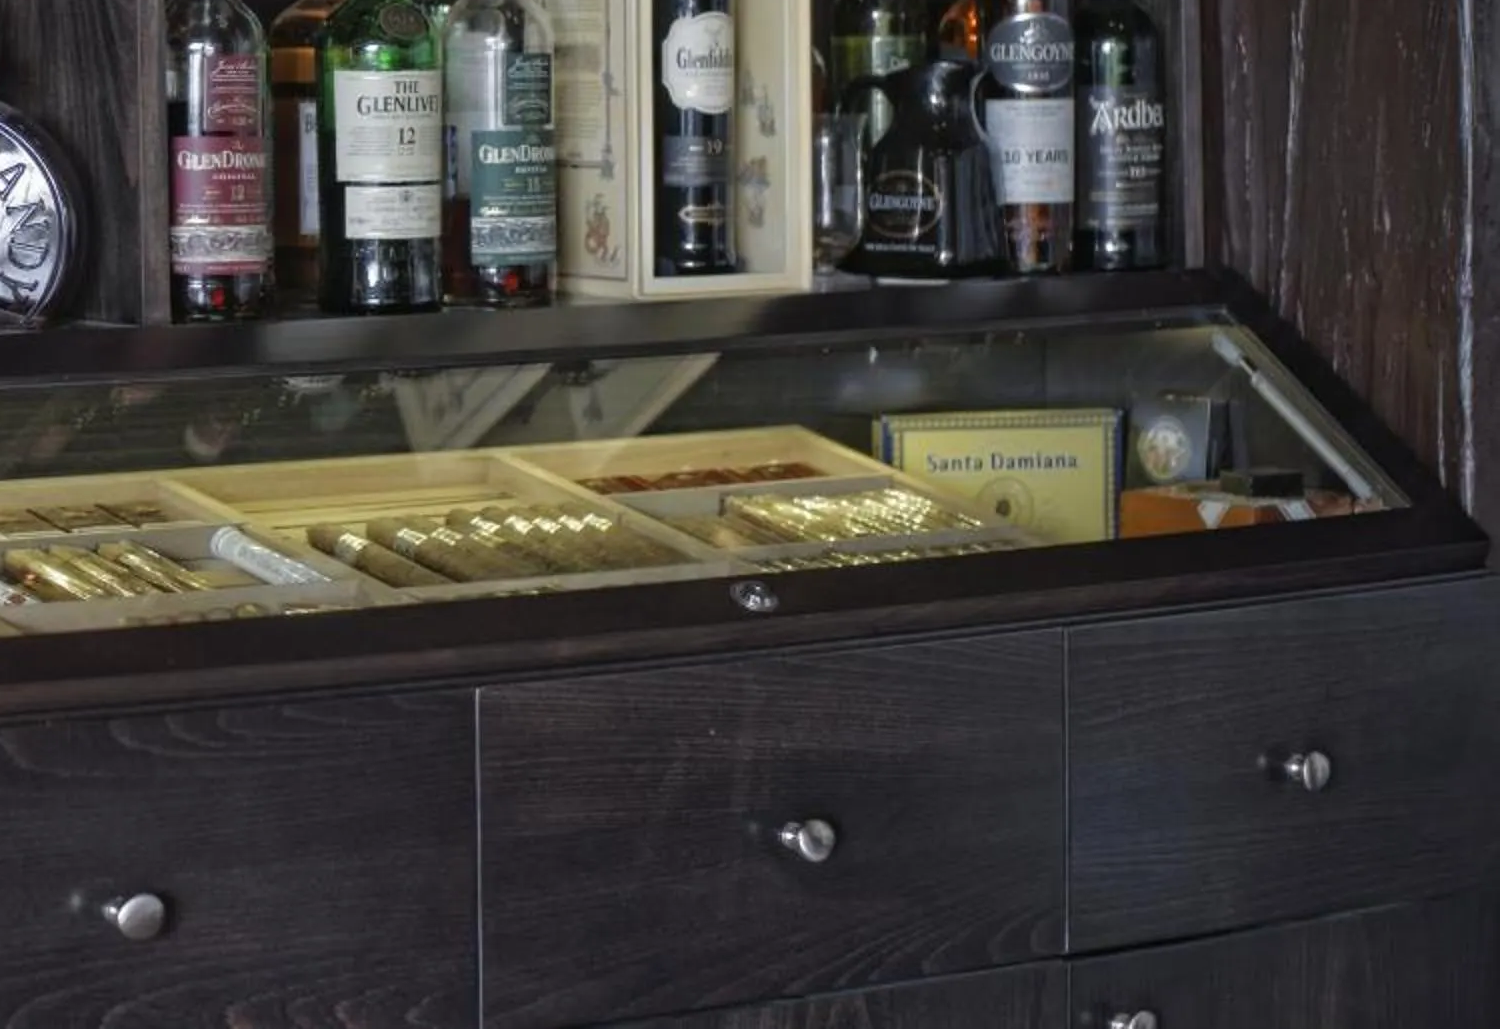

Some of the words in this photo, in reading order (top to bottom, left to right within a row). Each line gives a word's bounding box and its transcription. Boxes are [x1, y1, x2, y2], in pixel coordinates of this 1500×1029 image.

[394, 76, 420, 94] THE
[398, 126, 417, 146] 12
[1003, 150, 1021, 165] 10
[1026, 149, 1069, 165] YEARS
[926, 453, 984, 473] Santa
[990, 450, 1080, 471] Damiana
